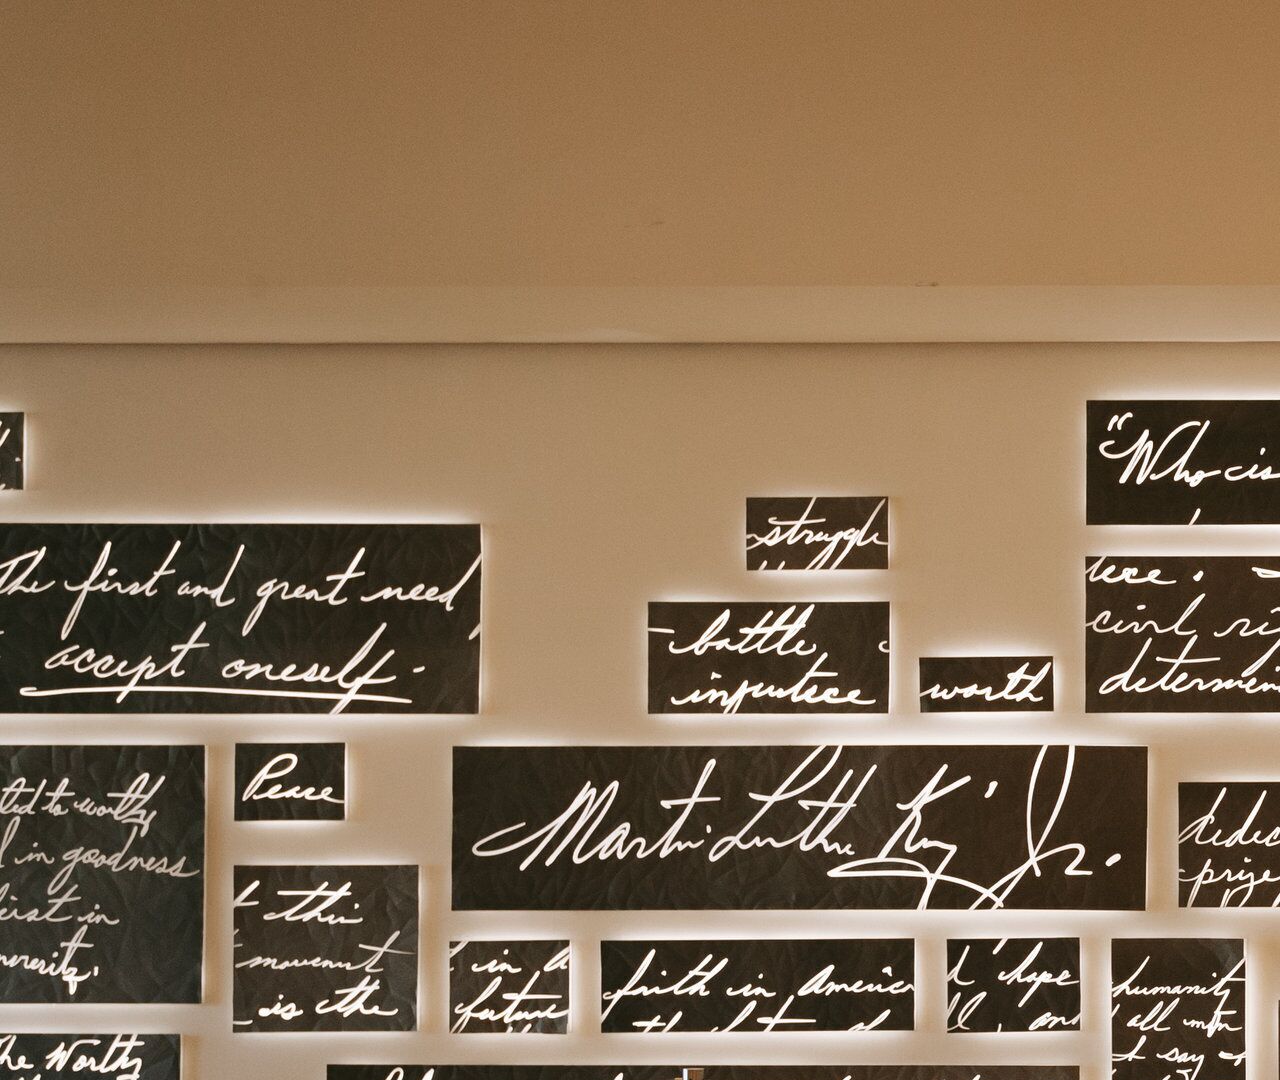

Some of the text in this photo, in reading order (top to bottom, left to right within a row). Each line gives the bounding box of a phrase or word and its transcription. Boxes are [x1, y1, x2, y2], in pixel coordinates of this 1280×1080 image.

[64, 540, 177, 640] first
[177, 544, 245, 608] and
[255, 546, 367, 637] great
[360, 553, 482, 612] need
[1086, 593, 1207, 635] civil
[668, 603, 819, 657] battle
[44, 621, 211, 705] accept
[670, 652, 878, 715] injustice
[919, 661, 1053, 703] worth
[242, 752, 346, 802] Peace
[472, 759, 713, 871] Martin
[14, 842, 55, 865] in
[47, 825, 200, 895] goodness
[77, 904, 120, 925] in
[471, 949, 523, 974] in
[601, 948, 729, 1023] faith
[726, 973, 777, 998] in
[997, 941, 1081, 1008] hope
[258, 975, 400, 1021] is the
[1126, 998, 1181, 1032] all
